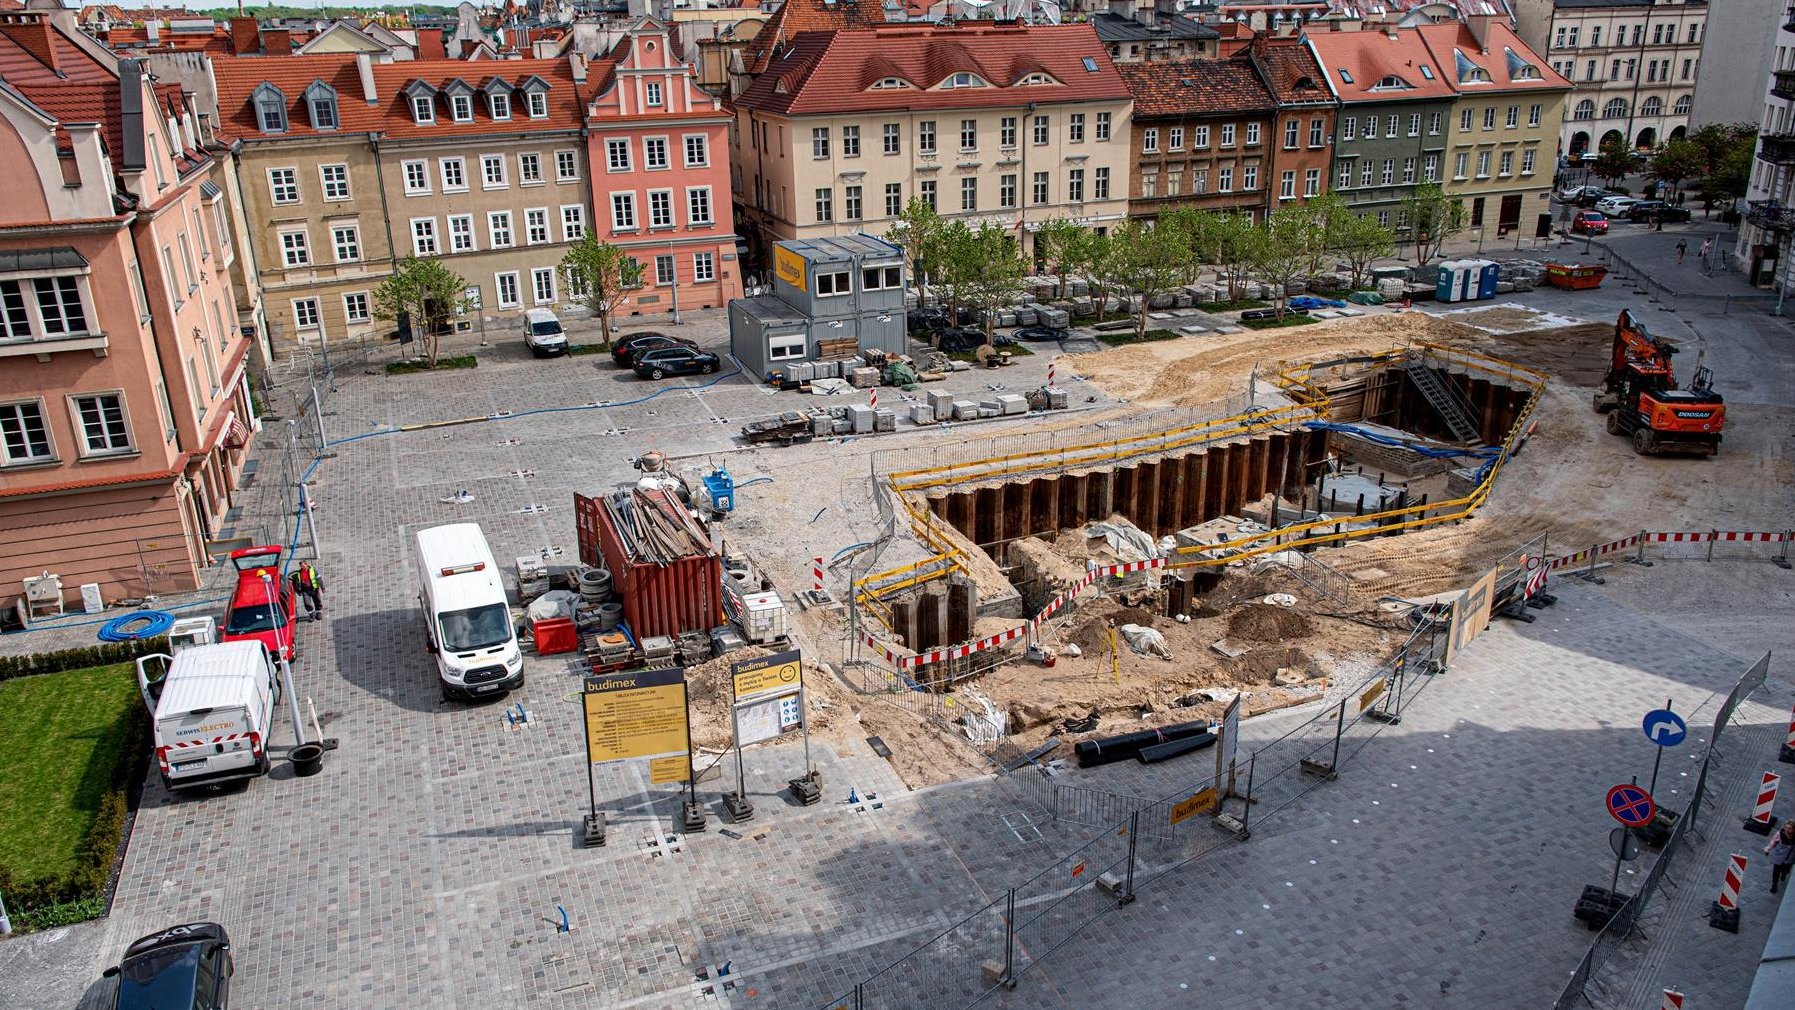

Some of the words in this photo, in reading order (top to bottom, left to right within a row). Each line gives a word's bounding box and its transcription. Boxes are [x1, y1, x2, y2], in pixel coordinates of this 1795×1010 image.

[737, 661, 769, 673] budimex
[588, 679, 636, 691] budimex
[200, 721, 234, 733] ELECTRO
[1176, 797, 1210, 818] budimex
